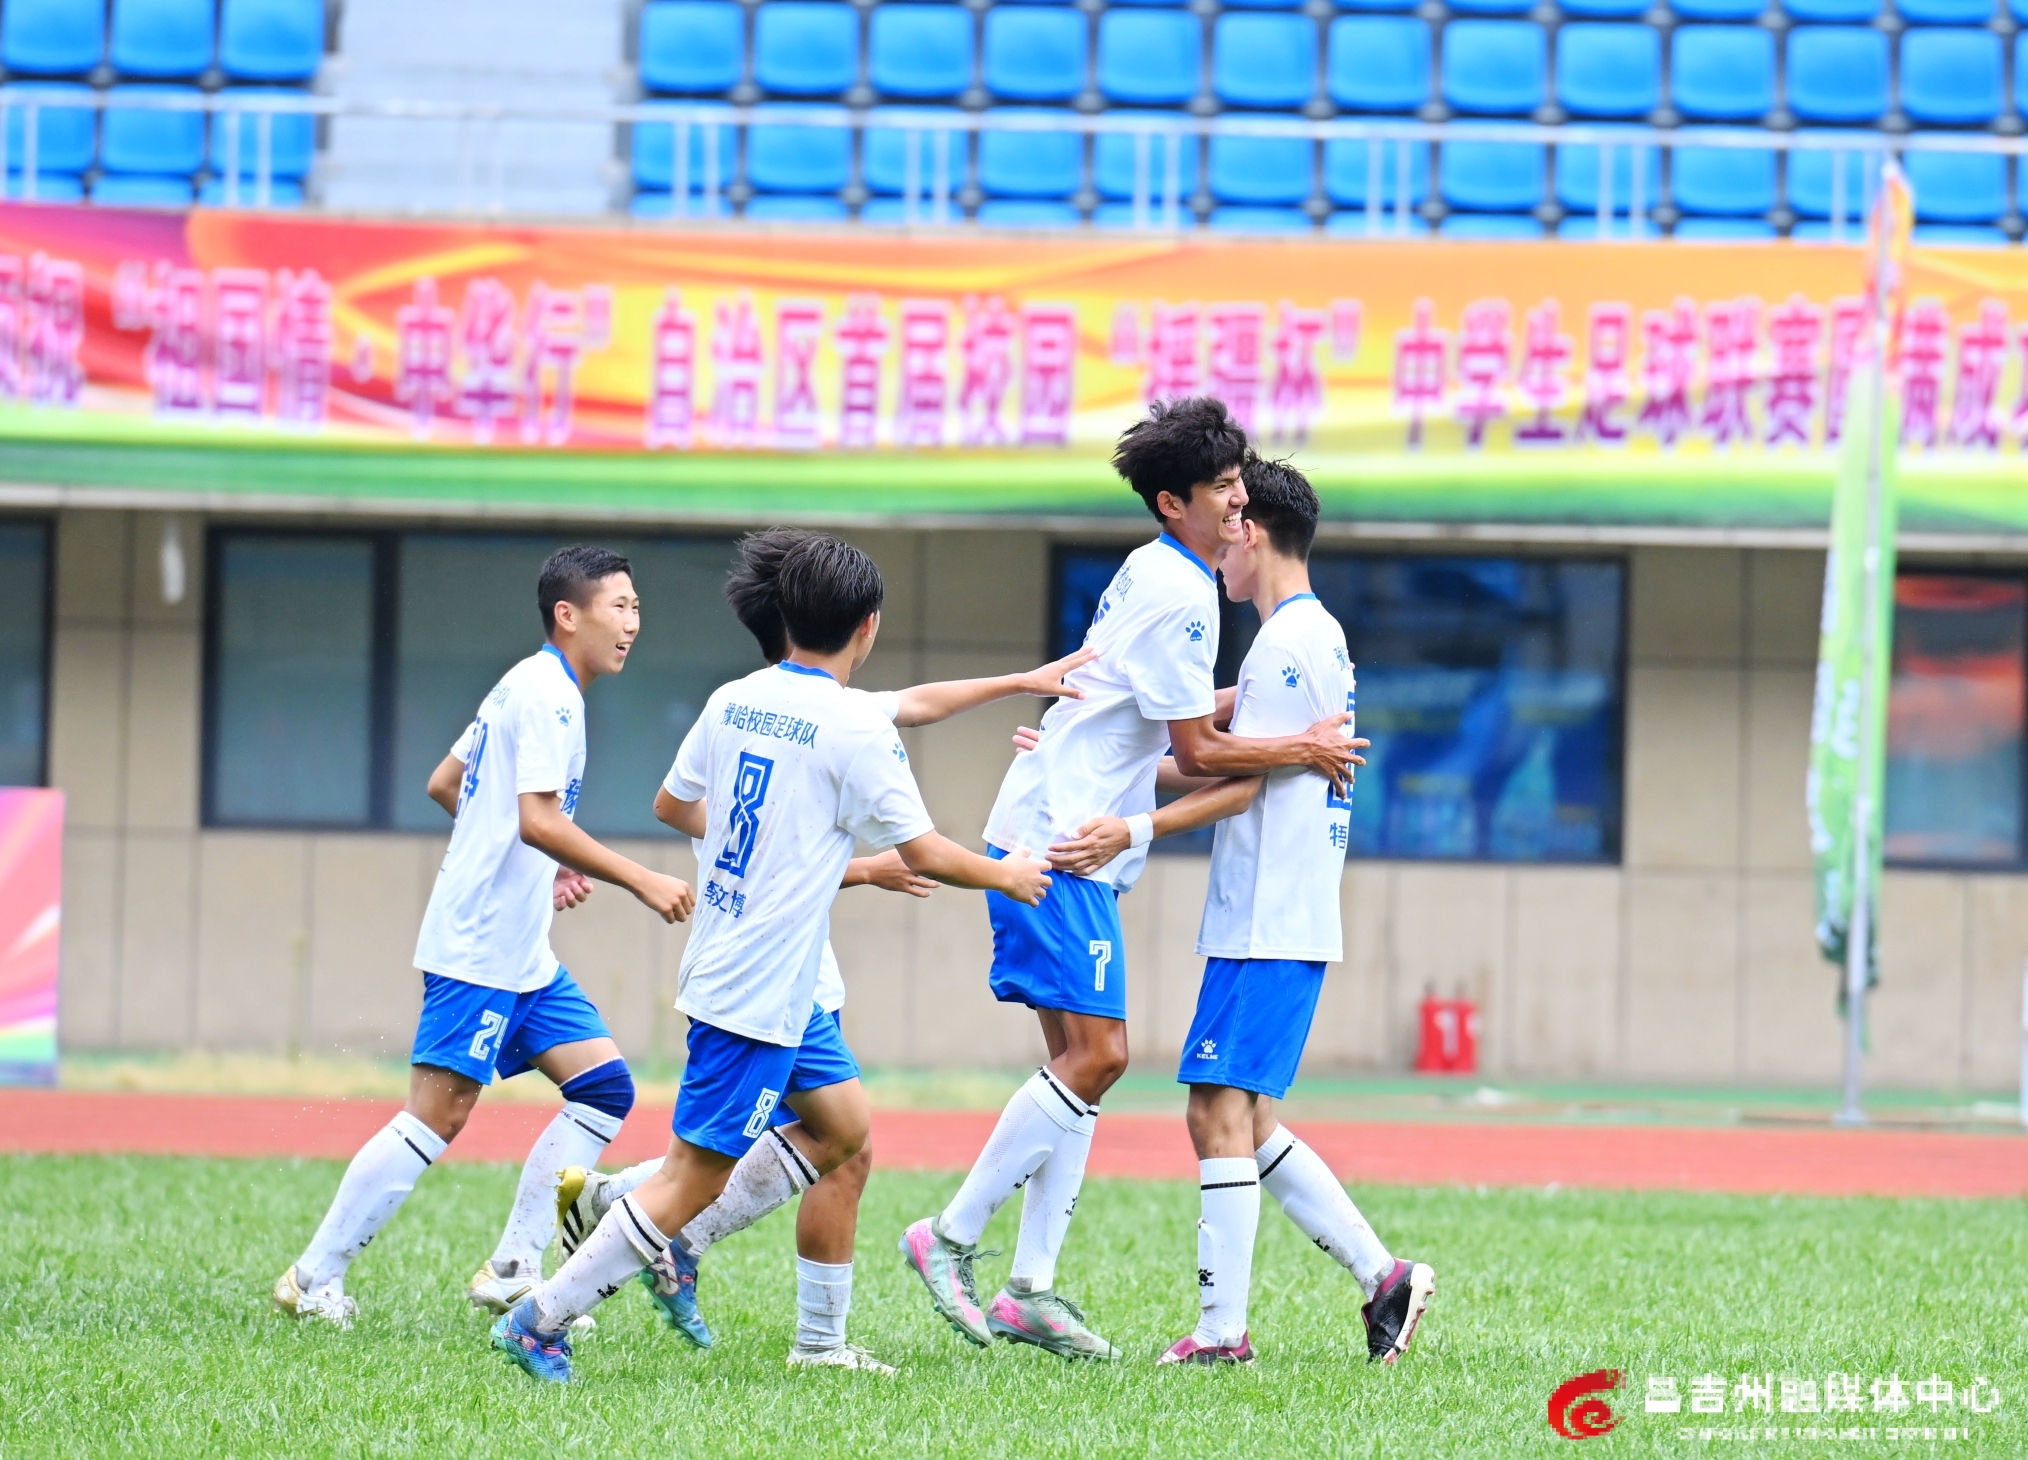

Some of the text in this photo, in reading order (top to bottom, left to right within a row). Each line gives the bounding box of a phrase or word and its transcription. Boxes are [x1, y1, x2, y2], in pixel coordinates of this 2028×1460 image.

[720, 702, 819, 750] 豫哈校园足球队
[714, 751, 775, 879] 8
[704, 880, 747, 919] 李文博
[1088, 939, 1112, 992] 7
[1196, 1052, 1218, 1060] KELME
[741, 1087, 780, 1139] 8
